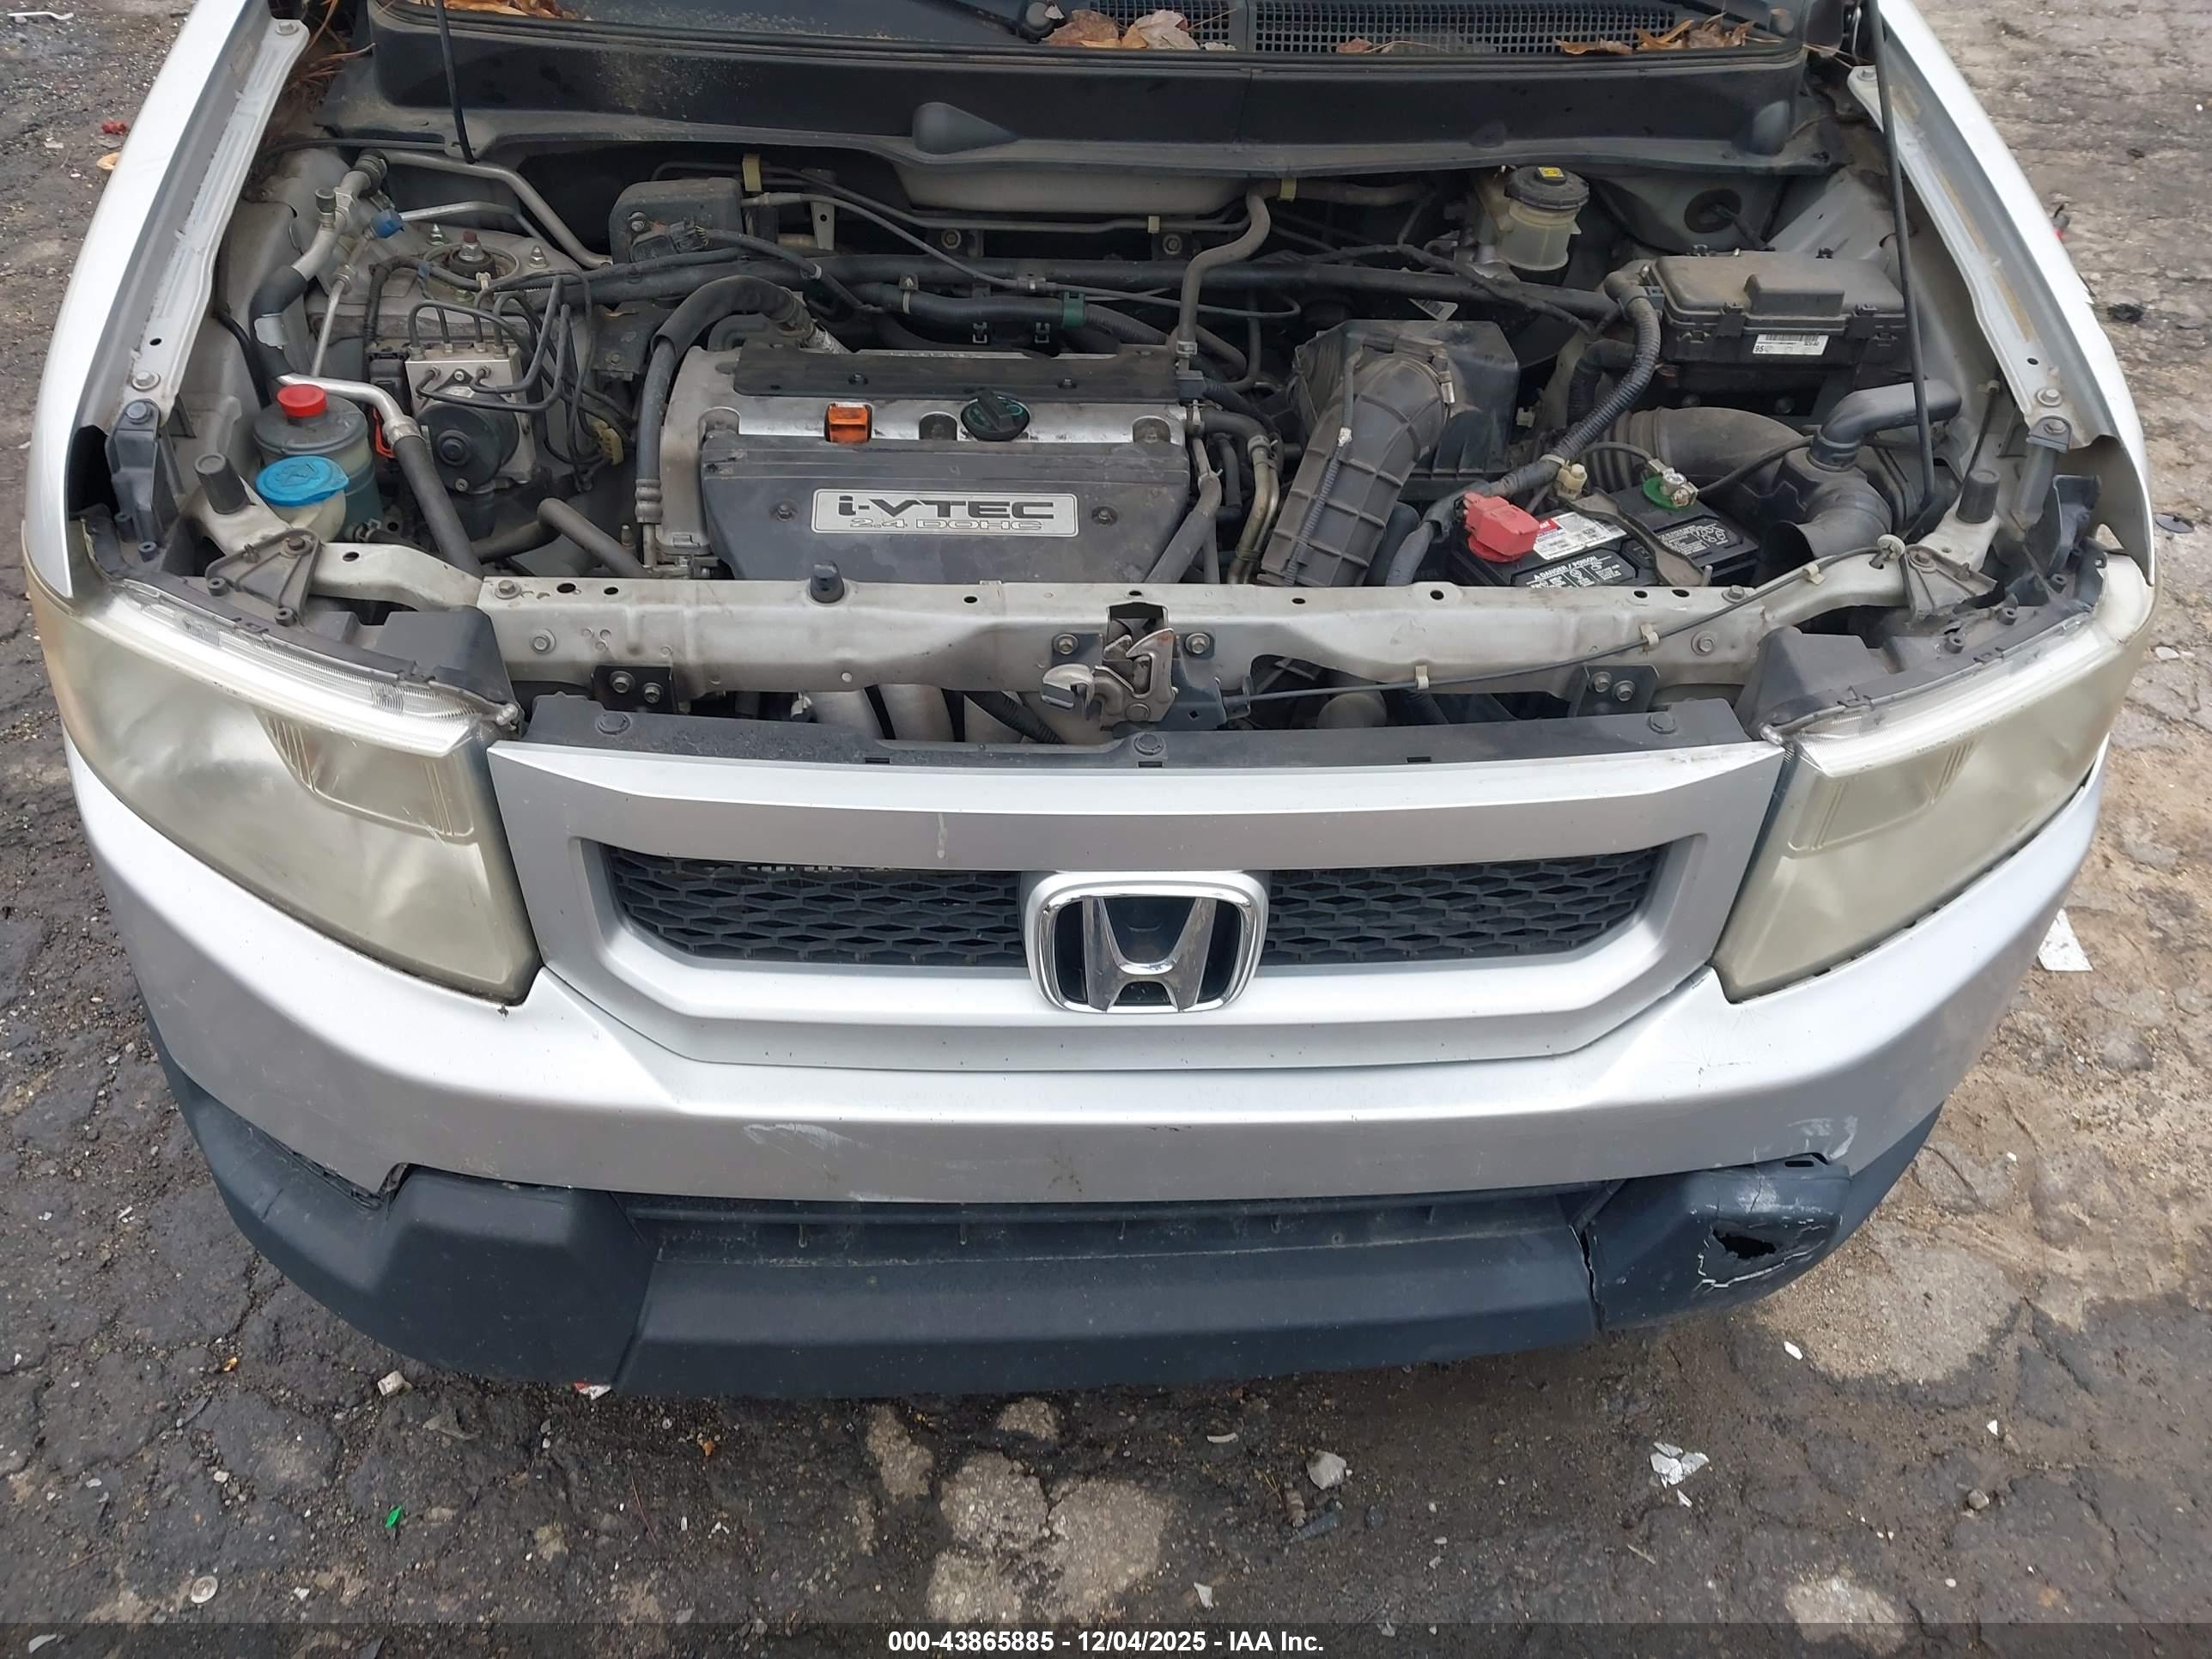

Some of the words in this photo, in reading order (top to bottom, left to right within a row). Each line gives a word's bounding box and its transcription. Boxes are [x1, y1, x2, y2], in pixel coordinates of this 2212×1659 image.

[838, 495, 1054, 520] i-VTEC
[849, 518, 906, 529] 2.4
[915, 519, 1044, 531] DOHC
[1539, 565, 1569, 578] DANGER
